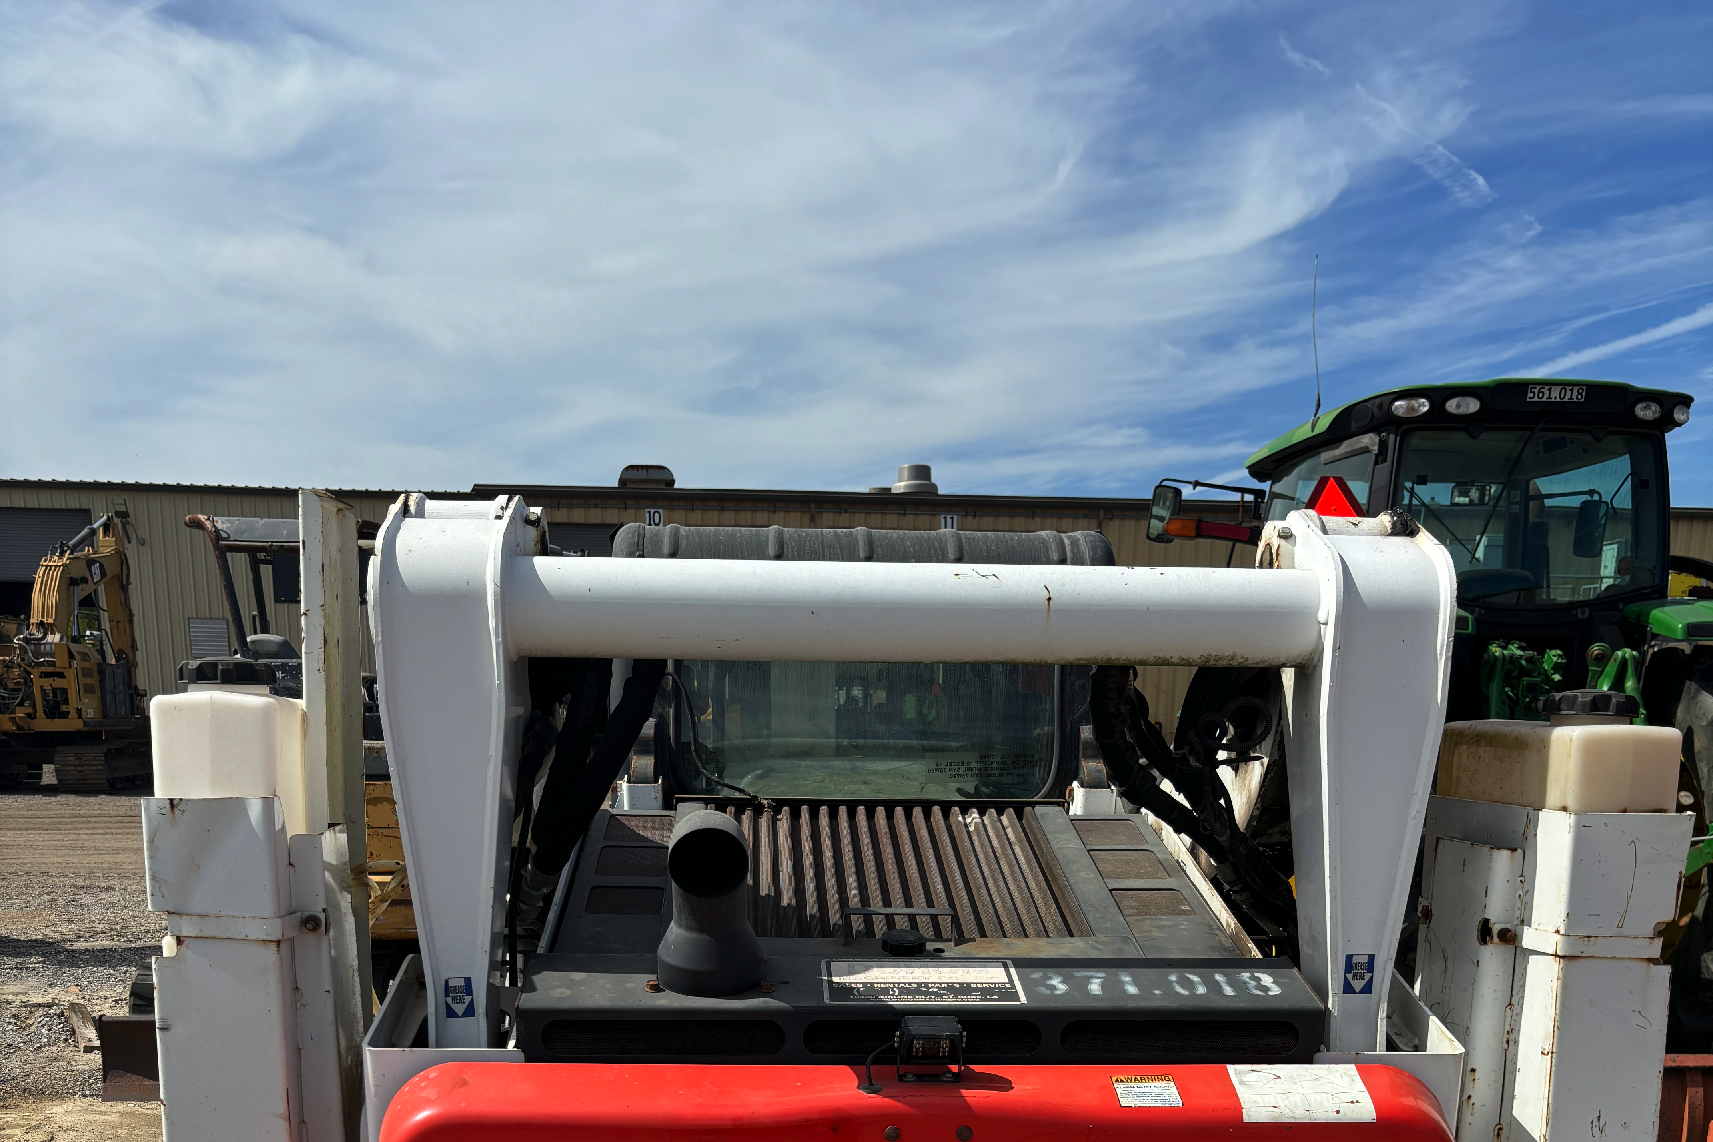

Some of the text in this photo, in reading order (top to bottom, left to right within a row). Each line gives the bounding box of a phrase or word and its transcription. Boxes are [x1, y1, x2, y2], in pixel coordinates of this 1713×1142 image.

[1528, 386, 1585, 401] 561.018
[647, 510, 661, 526] 10
[942, 516, 954, 529] 11
[91, 562, 102, 583] CAT
[1352, 961, 1368, 971] GREASE
[1351, 971, 1366, 981] HERE
[1029, 971, 1282, 996] 371.018
[449, 985, 466, 994] GREASE
[450, 994, 466, 1004] HERE
[1124, 1075, 1171, 1084] WARNING
